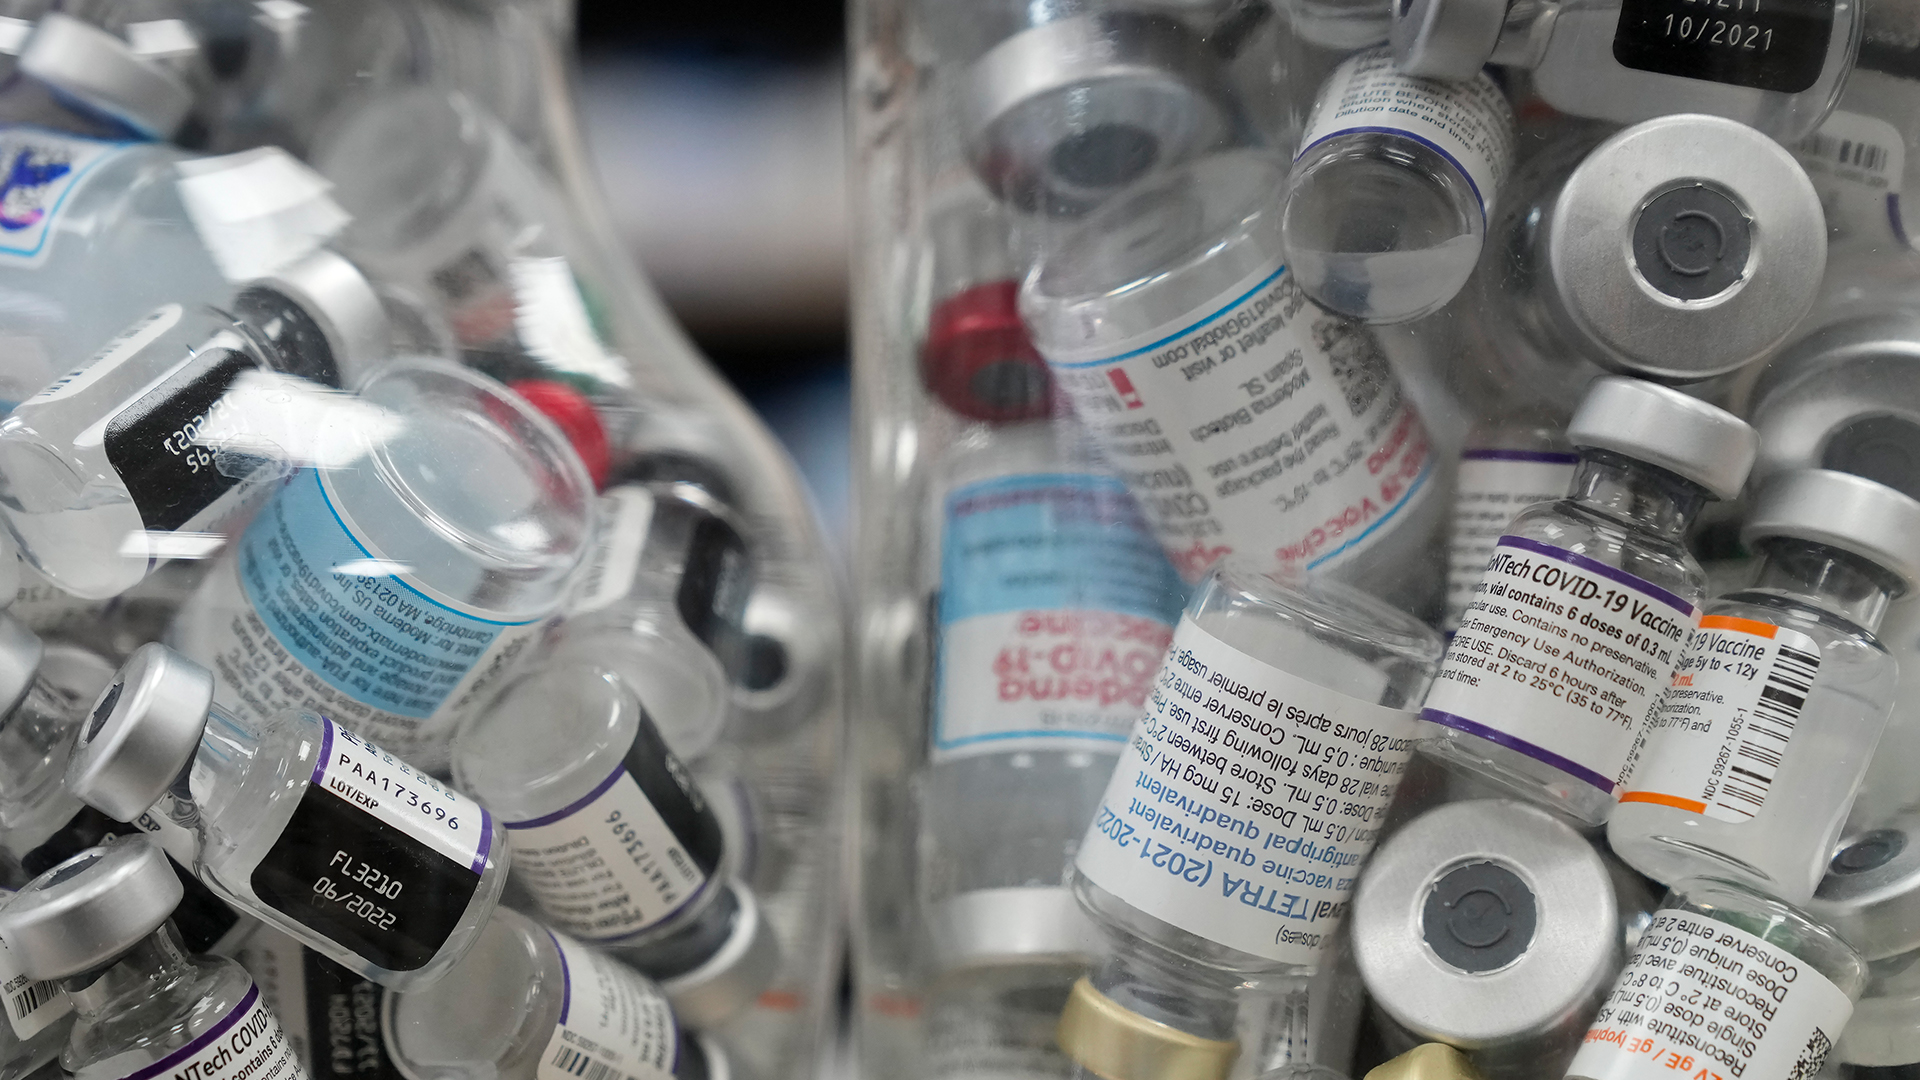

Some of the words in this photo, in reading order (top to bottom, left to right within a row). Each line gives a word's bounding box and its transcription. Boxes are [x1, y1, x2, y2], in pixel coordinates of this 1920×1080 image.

[1666, 14, 1772, 50] 10/2021
[1397, 99, 1433, 112] when
[1335, 107, 1384, 118] Dilution
[1389, 107, 1418, 116] date
[1422, 116, 1445, 129] and
[1449, 127, 1473, 152] time:
[1235, 311, 1289, 354] leaflet
[1216, 343, 1238, 364] or
[1179, 355, 1218, 384] visit
[1261, 347, 1307, 387] Spain
[353, 585, 372, 610] US,
[398, 600, 422, 620] MA
[1533, 565, 1628, 612] COVID-19
[1631, 600, 1682, 642] Vaccine
[316, 609, 381, 662] expiration
[374, 605, 432, 644] Moderna
[1490, 582, 1508, 596] vial
[1508, 589, 1563, 615] contains
[1568, 607, 1578, 620] 6
[1580, 613, 1622, 639] doses
[1626, 634, 1641, 646] of
[1641, 638, 1658, 656] 0.3
[1658, 650, 1672, 665] mL
[1489, 605, 1507, 617] use.
[1513, 609, 1567, 638] Contains
[1571, 633, 1588, 646] no
[1590, 642, 1656, 679] preservative.
[1709, 634, 1765, 660] Vaccine
[1178, 650, 1207, 678] usage.
[1471, 618, 1530, 647] Emergency
[1534, 638, 1560, 657] Use
[1563, 651, 1645, 696] Authorization.
[1696, 656, 1708, 671] 5y
[1710, 658, 1720, 670] to
[1737, 662, 1758, 679] 12y
[1443, 669, 1457, 679] and
[1457, 671, 1480, 687] time:
[1471, 639, 1493, 655] USE.
[1498, 647, 1547, 673] Discard
[1550, 667, 1559, 678] 6
[1561, 671, 1598, 695] hours
[1600, 691, 1626, 707] after
[1678, 674, 1693, 686] mL
[1175, 678, 1202, 702] entre
[1208, 672, 1266, 706] premier
[1456, 653, 1486, 668] stored
[1487, 663, 1499, 673] at
[1501, 665, 1510, 676] 2
[1513, 670, 1526, 682] to
[1530, 676, 1564, 696] 25°C
[1567, 690, 1588, 707] (35
[1591, 701, 1603, 714] to
[1606, 707, 1632, 730] 77°F).
[1672, 690, 1724, 704] preservative.
[1170, 702, 1191, 724] use.
[1203, 697, 1285, 744] Conserver
[1268, 699, 1283, 718] le
[1286, 707, 1331, 732] après
[1192, 717, 1220, 743] first
[1334, 724, 1373, 744] jours
[1668, 717, 1690, 731] 77°F)
[1691, 720, 1712, 732] and
[1168, 731, 1227, 774] between
[1223, 730, 1298, 776] following
[1293, 735, 1321, 755] mL.
[1370, 735, 1388, 752] 28
[1702, 779, 1718, 800] NDC
[1712, 708, 1747, 776] 59267-1055-1
[1161, 754, 1181, 779] HA
[1323, 747, 1348, 766] 0,5
[1360, 756, 1397, 776] unique
[1183, 765, 1218, 793] mcg
[1231, 764, 1276, 794] Store
[1302, 765, 1338, 788] days
[1340, 778, 1360, 795] 28
[330, 777, 378, 809] LOT/EXP
[339, 754, 458, 829] PAA173696
[1220, 787, 1240, 807] 15
[1284, 783, 1311, 803] mL.
[1359, 782, 1379, 798] vial
[1136, 771, 1259, 839] quadrivalent
[1247, 797, 1297, 828] Dose:
[1312, 795, 1337, 815] 0.5
[1341, 802, 1373, 822] Dose:
[136, 811, 162, 836] EXP
[1129, 798, 1255, 866] quadrivalent
[1303, 815, 1323, 832] mL
[1324, 824, 1346, 842] 0.5
[1263, 833, 1359, 867] antigrippal
[330, 851, 402, 899] FL3210
[1263, 861, 1332, 889] vaccine
[313, 877, 396, 930] 06/2022
[1223, 872, 1309, 920] TETRA
[1665, 918, 1677, 932] 2
[1677, 920, 1714, 939] entre
[1660, 937, 1688, 954] (0,5
[1645, 955, 1676, 969] avec
[1690, 946, 1743, 975] unique
[1715, 934, 1797, 983] Conserver
[1649, 976, 1663, 989] to
[1666, 982, 1679, 996] C
[1679, 965, 1777, 1021] Reconstituer
[1747, 970, 1788, 1002] Dose
[1613, 988, 1635, 1003] mL)
[1633, 994, 1661, 1010] (0.5
[1681, 990, 1702, 1005] 2°
[1703, 996, 1721, 1011] at
[1618, 1010, 1643, 1026] with
[1664, 1003, 1704, 1027] dose
[1725, 1007, 1766, 1039] Store
[268, 1035, 279, 1049] 6
[1629, 1038, 1654, 1053] gE
[1648, 1019, 1746, 1078] Reconstitute
[1707, 1022, 1756, 1058] Single
[1665, 1053, 1694, 1071] gE
